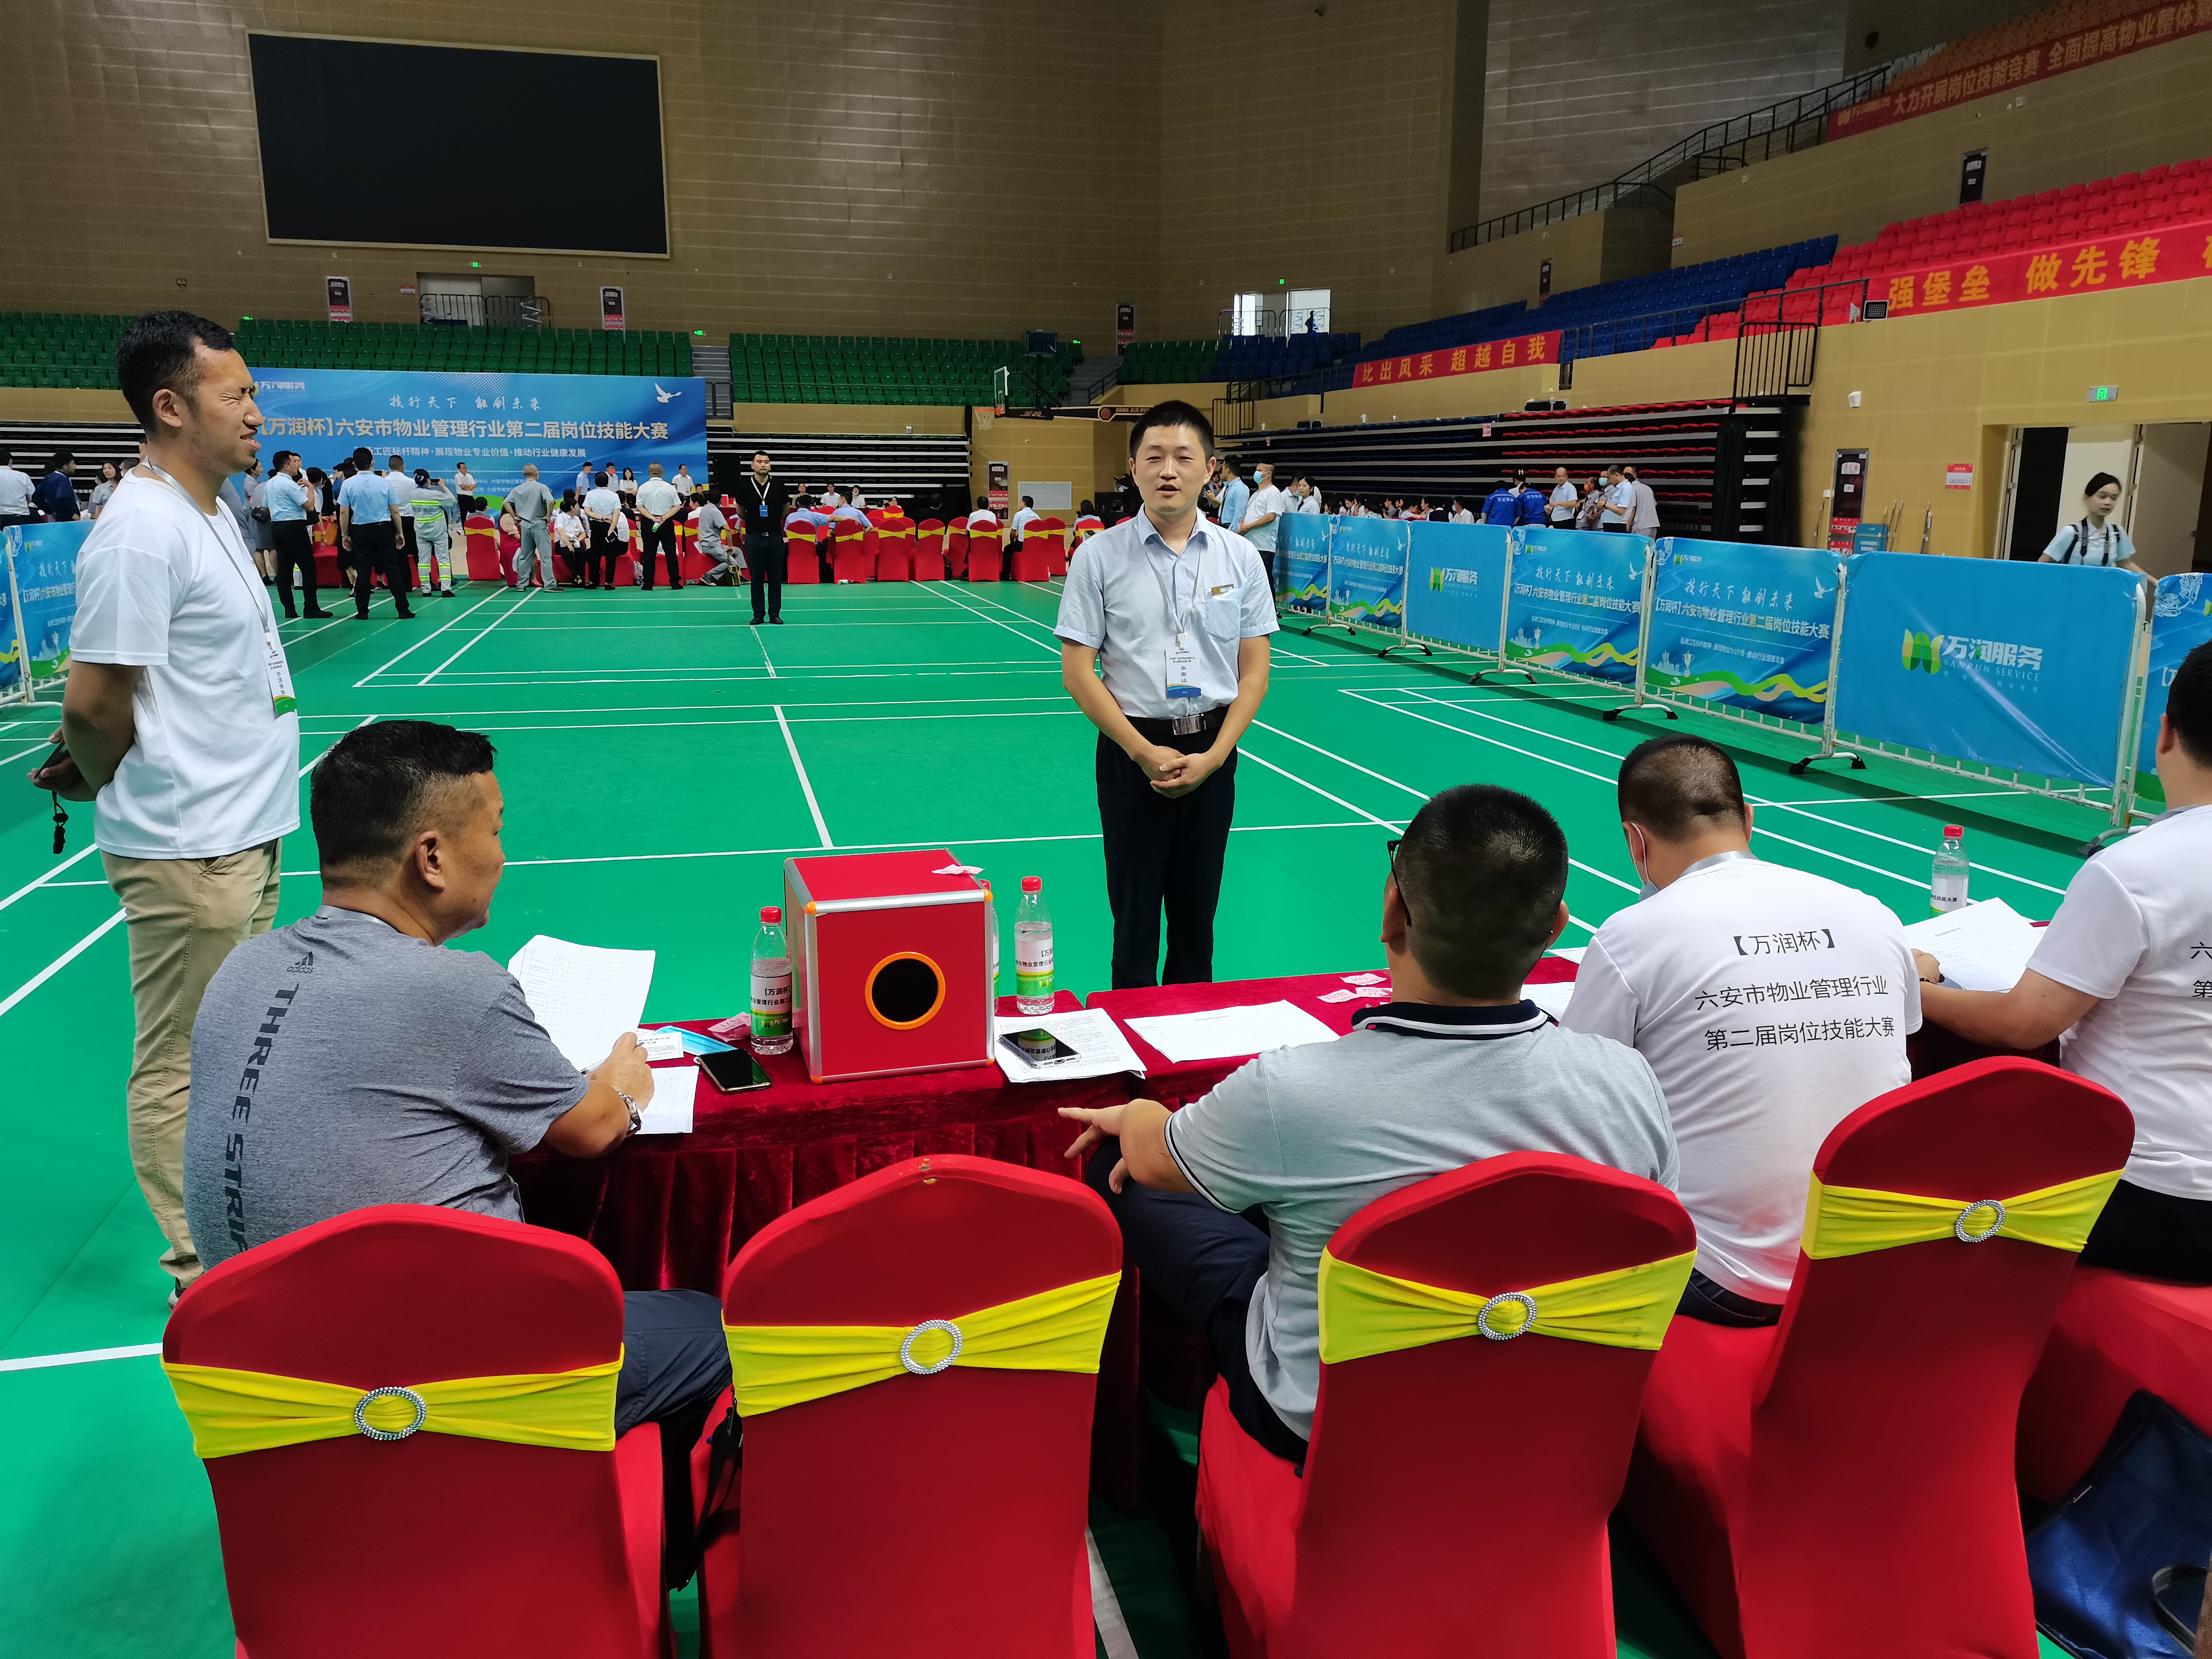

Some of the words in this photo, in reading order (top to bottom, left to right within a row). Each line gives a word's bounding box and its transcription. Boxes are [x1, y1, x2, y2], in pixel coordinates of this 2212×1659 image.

[2025, 237, 2160, 293] 做先锋
[1362, 354, 1433, 382] 比出风采
[1451, 335, 1546, 372] 超越自我
[1684, 577, 1734, 601] 技行天下
[1942, 635, 2043, 671] 万润服务
[1996, 666, 2040, 682] SERVICE
[1733, 928, 1835, 956] 【万润杯】
[286, 966, 314, 974] adidas
[1695, 975, 1889, 1011] 六安市物业管理行业
[1704, 1016, 1895, 1051] 第二届岗位技能大赛
[232, 982, 300, 1124] THREE
